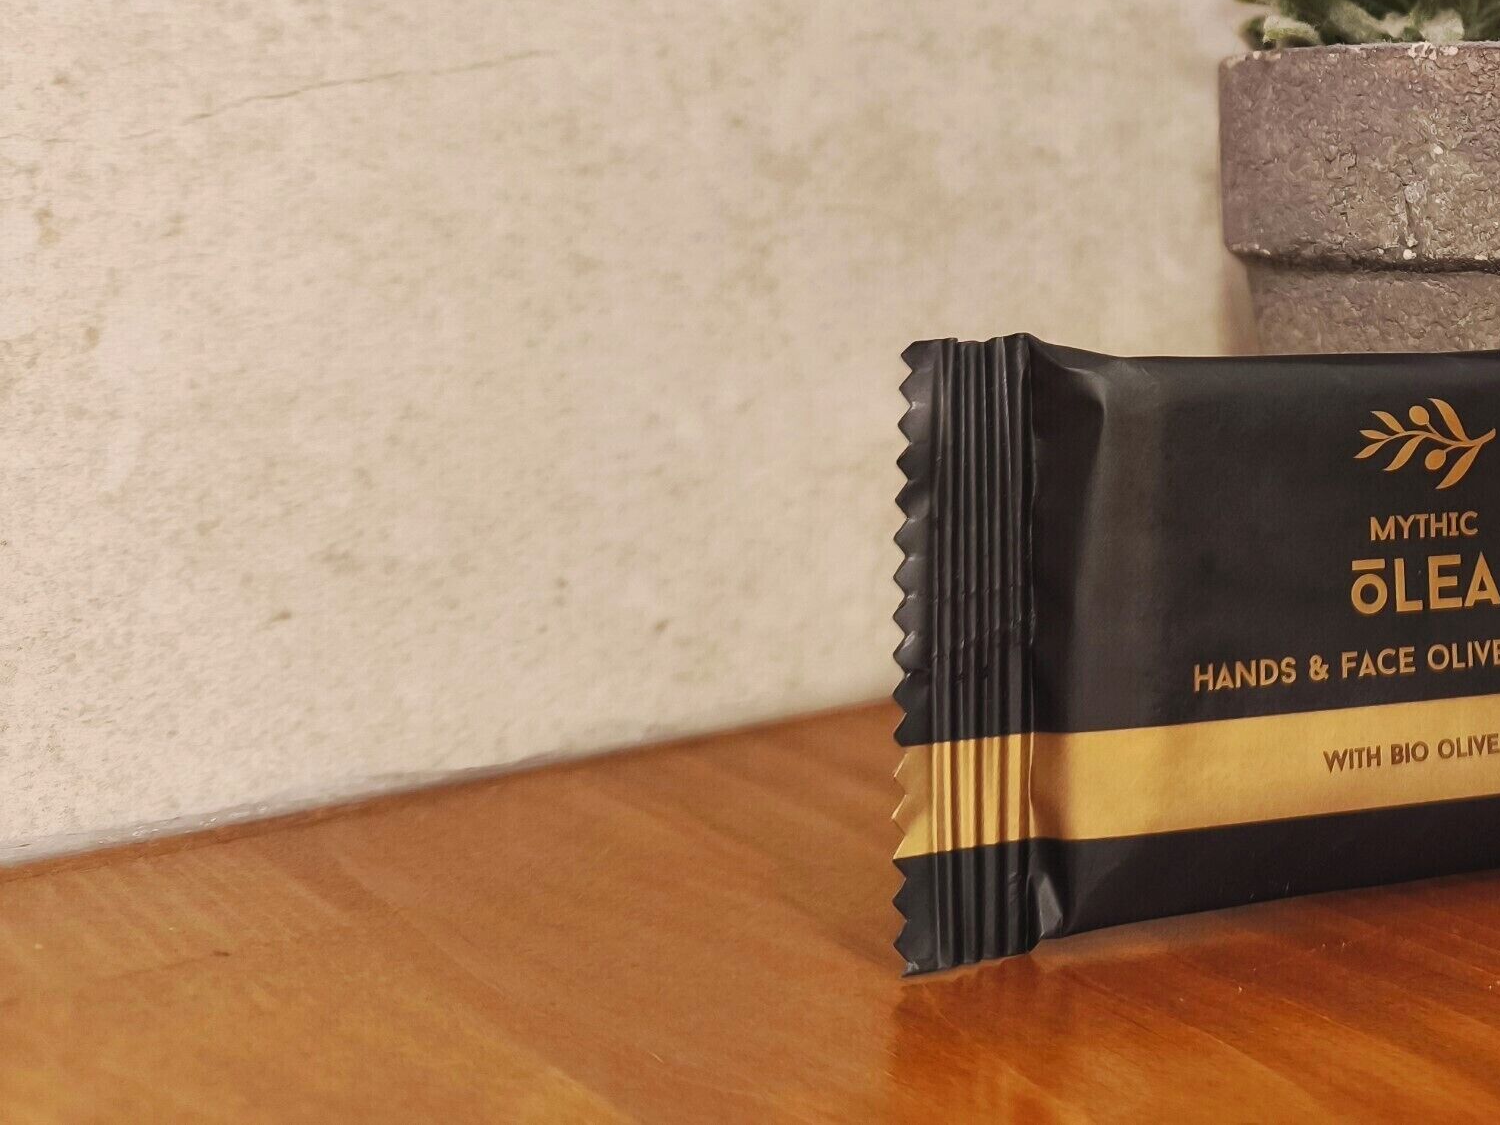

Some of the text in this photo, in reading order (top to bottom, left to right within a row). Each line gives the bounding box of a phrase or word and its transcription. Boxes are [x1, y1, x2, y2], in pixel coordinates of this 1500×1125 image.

[1370, 511, 1478, 541] MYTHIC
[1193, 657, 1297, 692] HANDS
[1308, 655, 1329, 682] &
[1341, 647, 1416, 678] FACE
[1323, 747, 1382, 772] WITH
[1390, 742, 1429, 764] BIO
[1437, 733, 1500, 760] OLIVE
